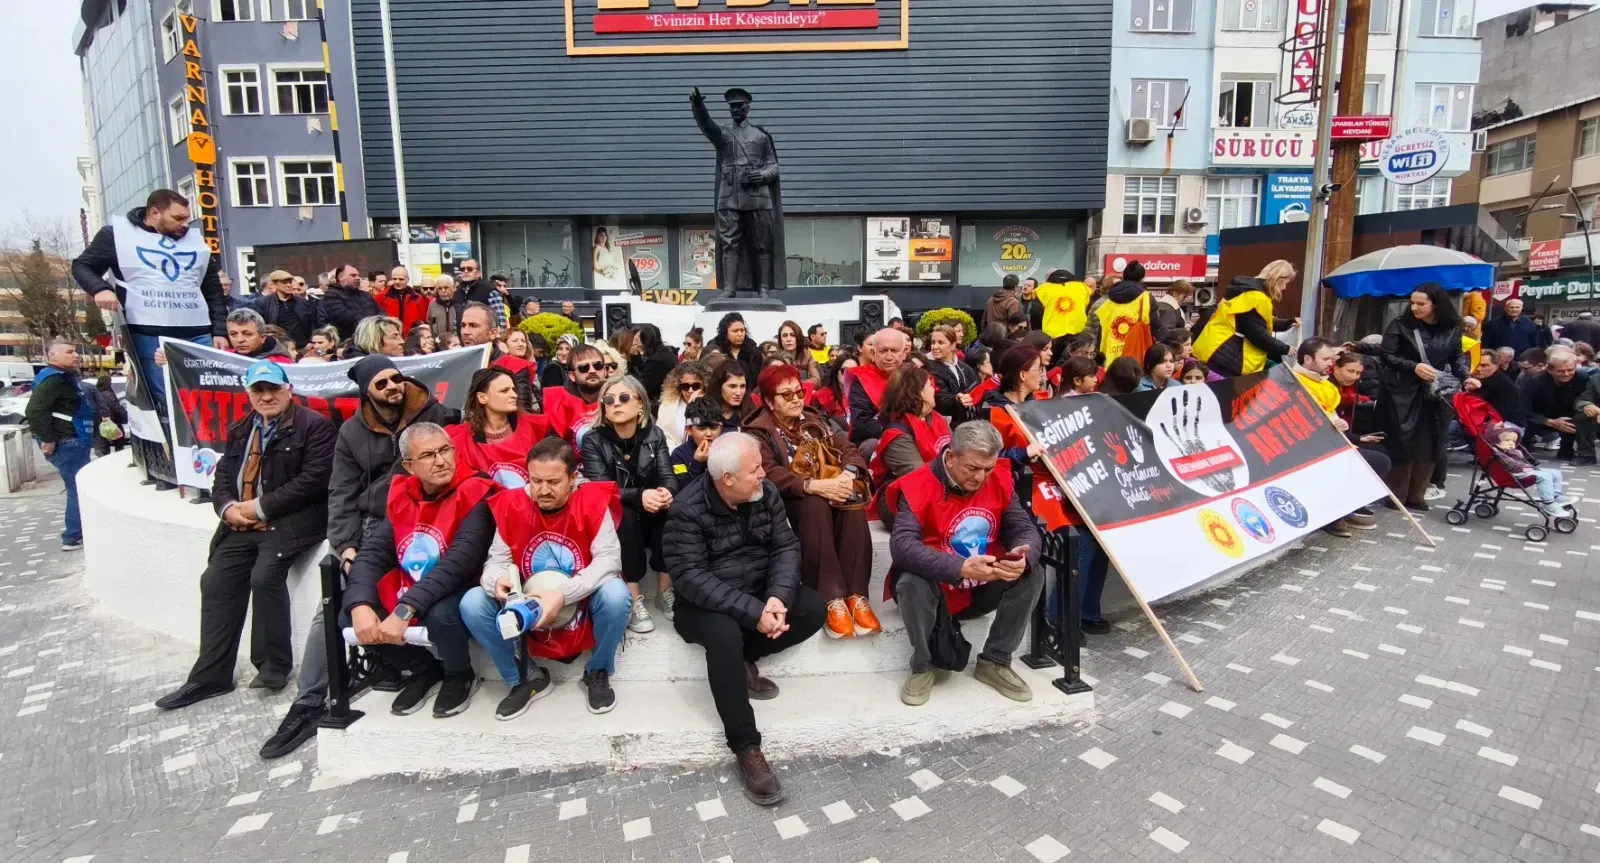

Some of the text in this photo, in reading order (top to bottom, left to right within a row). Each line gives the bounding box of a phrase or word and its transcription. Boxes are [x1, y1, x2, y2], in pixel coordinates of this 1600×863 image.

[709, 14, 732, 25] Her
[180, 13, 208, 127] VARNA
[1215, 132, 1303, 157] SÜRÜCÜ
[1395, 141, 1434, 152] ÜCRETSİZ
[1405, 127, 1447, 153] BELEDİYESİ
[195, 170, 221, 254] HOTE
[1001, 243, 1027, 260] 20
[1519, 282, 1566, 299] Peynir
[200, 371, 240, 386] EĞİTİMDE
[1035, 405, 1094, 449] EĞİTİMDE
[1085, 459, 1109, 485] DE!
